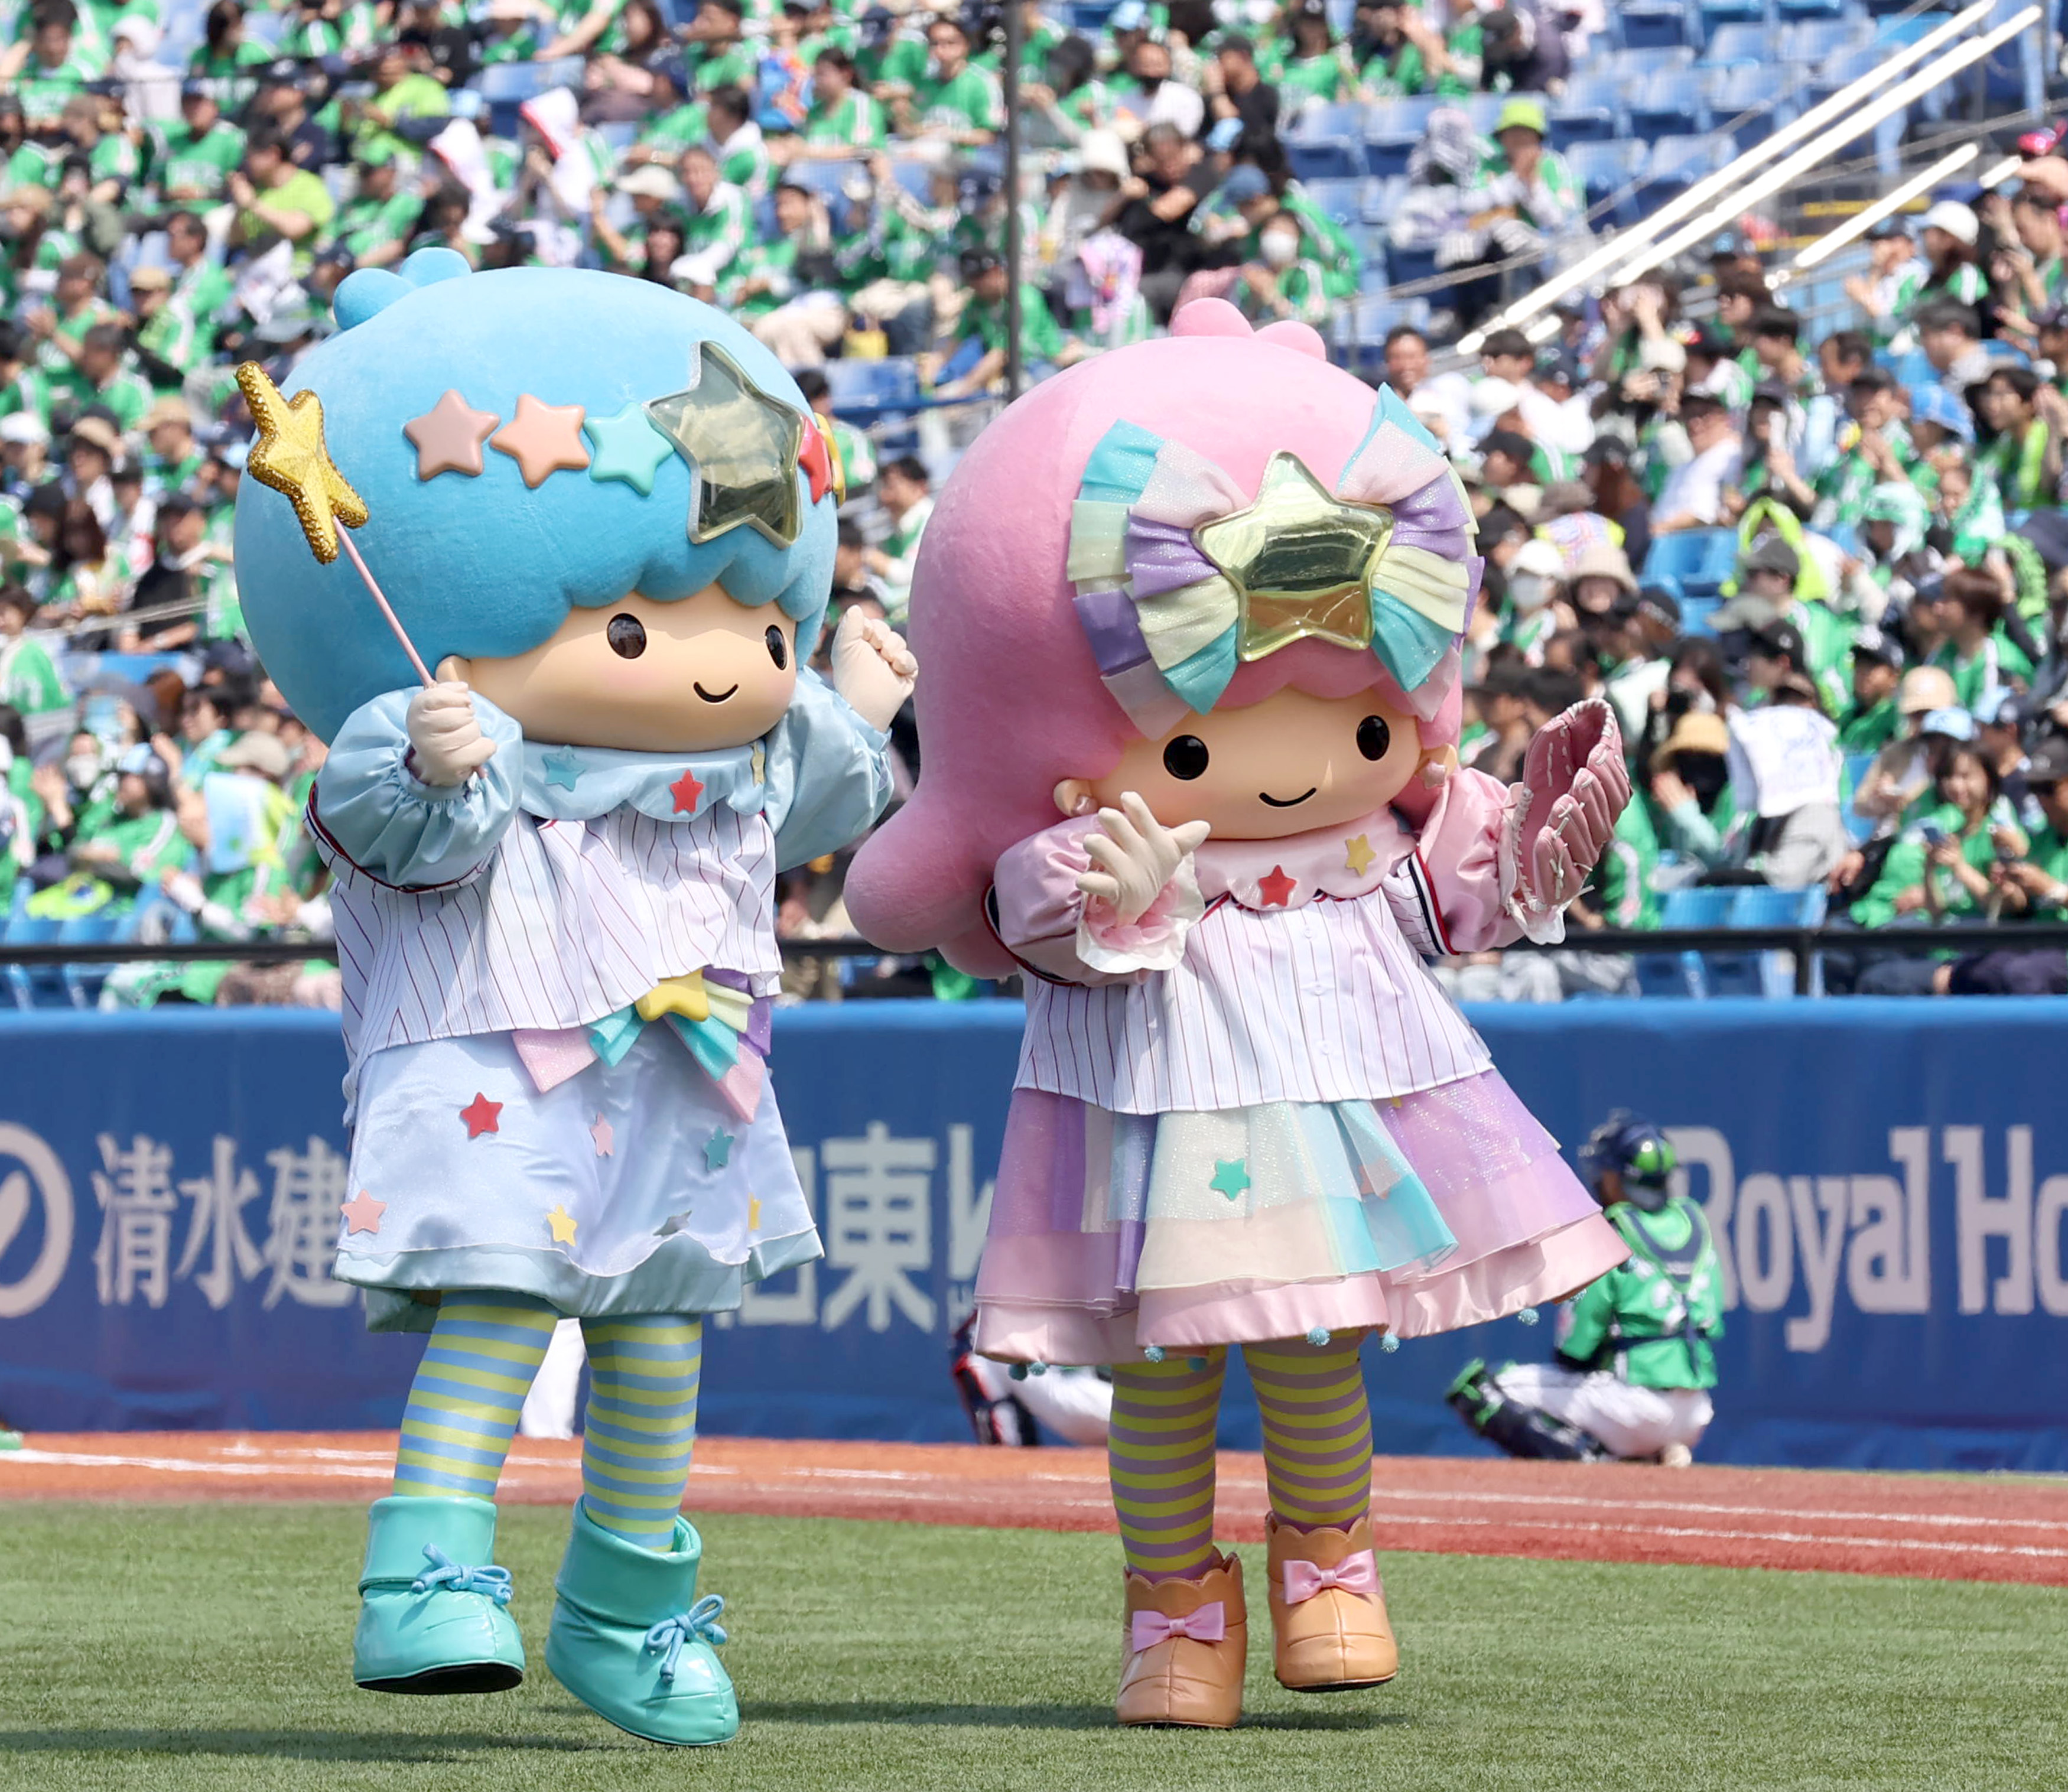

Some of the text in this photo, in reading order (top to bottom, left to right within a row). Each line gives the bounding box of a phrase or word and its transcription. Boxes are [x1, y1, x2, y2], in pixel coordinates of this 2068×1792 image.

[90, 1131, 366, 1312] 清水建
[1661, 1124, 1930, 1354] Royal
